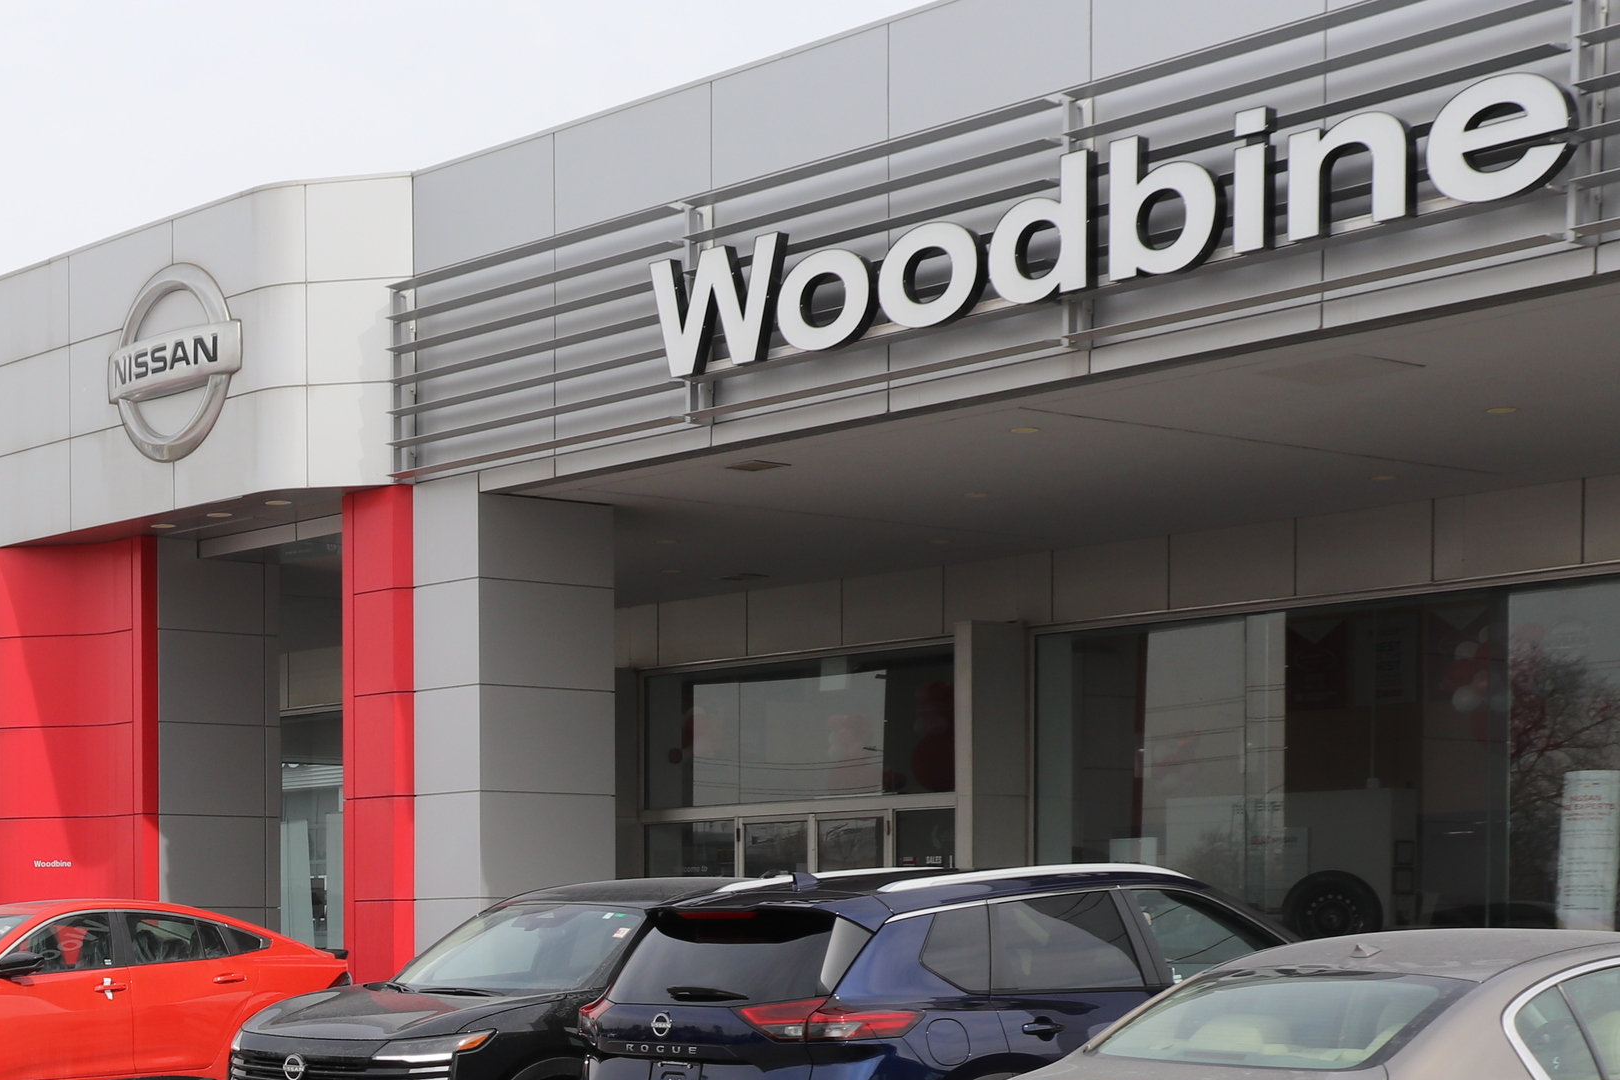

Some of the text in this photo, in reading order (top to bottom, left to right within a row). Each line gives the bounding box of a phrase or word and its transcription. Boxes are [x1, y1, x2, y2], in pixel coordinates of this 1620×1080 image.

[649, 71, 1575, 378] Woodbine
[114, 333, 219, 388] NISSAN
[32, 859, 73, 869] Woodbine
[925, 855, 943, 864] SALES
[625, 1043, 698, 1055] ROGUE
